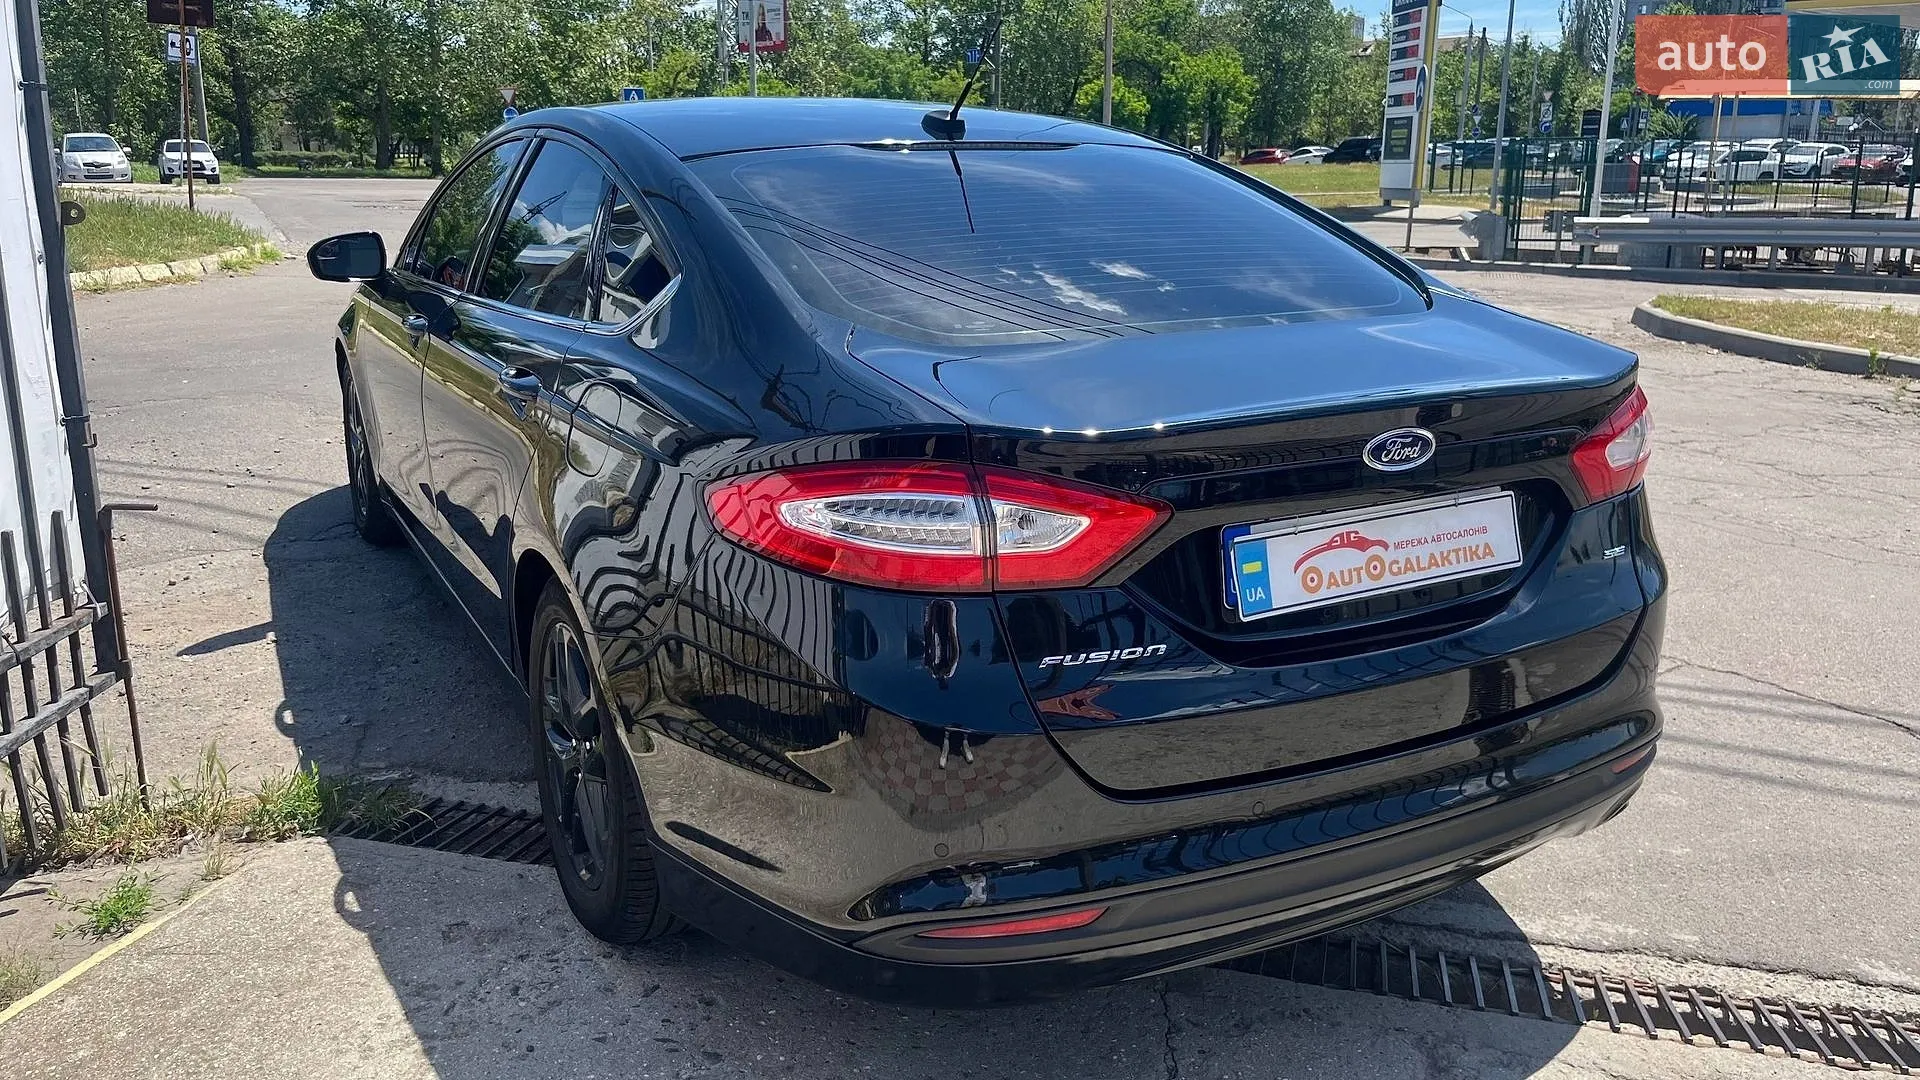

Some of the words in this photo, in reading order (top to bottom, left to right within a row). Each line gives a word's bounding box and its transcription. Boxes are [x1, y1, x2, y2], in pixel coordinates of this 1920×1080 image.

[1381, 437, 1422, 462] Ford
[1393, 537, 1430, 551] МЕРЕЖА
[1430, 525, 1488, 544] АВТОСАЛОНІВ
[1246, 586, 1266, 602] UA
[1039, 644, 1167, 668] FUSION
